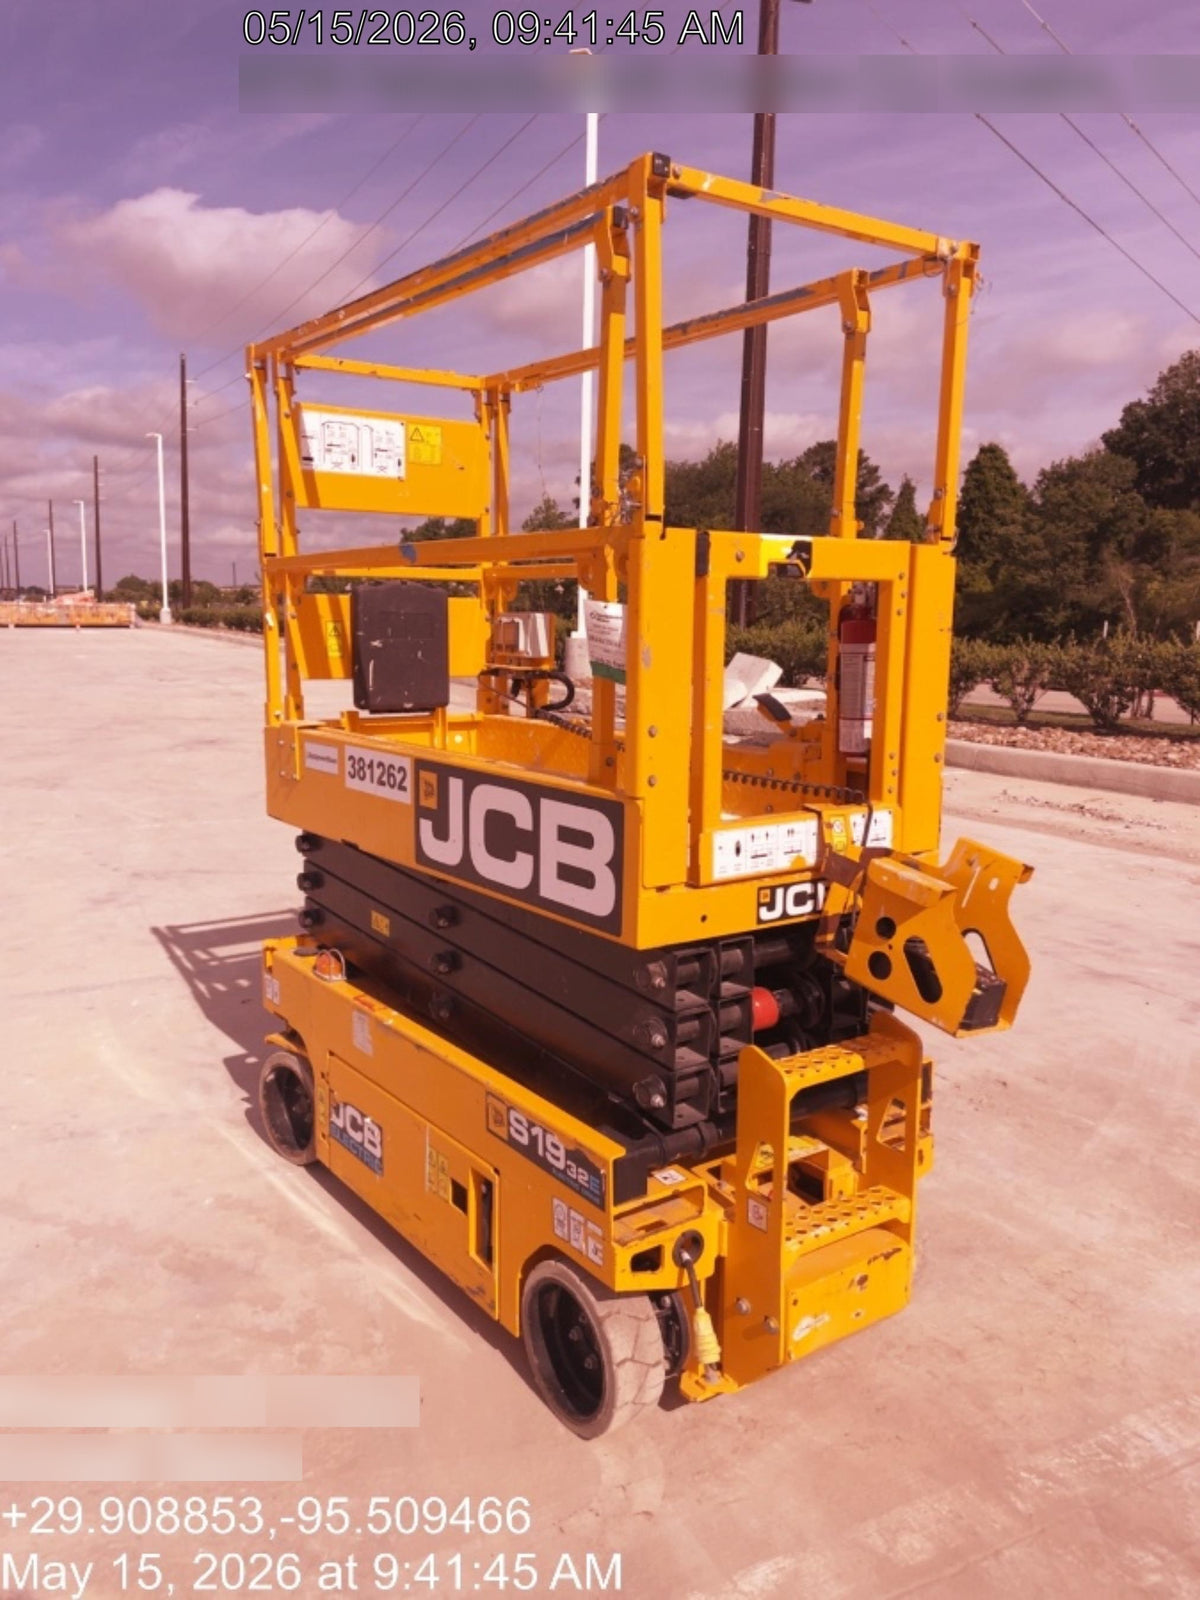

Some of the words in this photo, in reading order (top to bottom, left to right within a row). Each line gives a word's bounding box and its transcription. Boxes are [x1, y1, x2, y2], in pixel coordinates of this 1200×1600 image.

[348, 755, 407, 792] 381262
[419, 776, 616, 917] JCB
[330, 1103, 381, 1158] JCB
